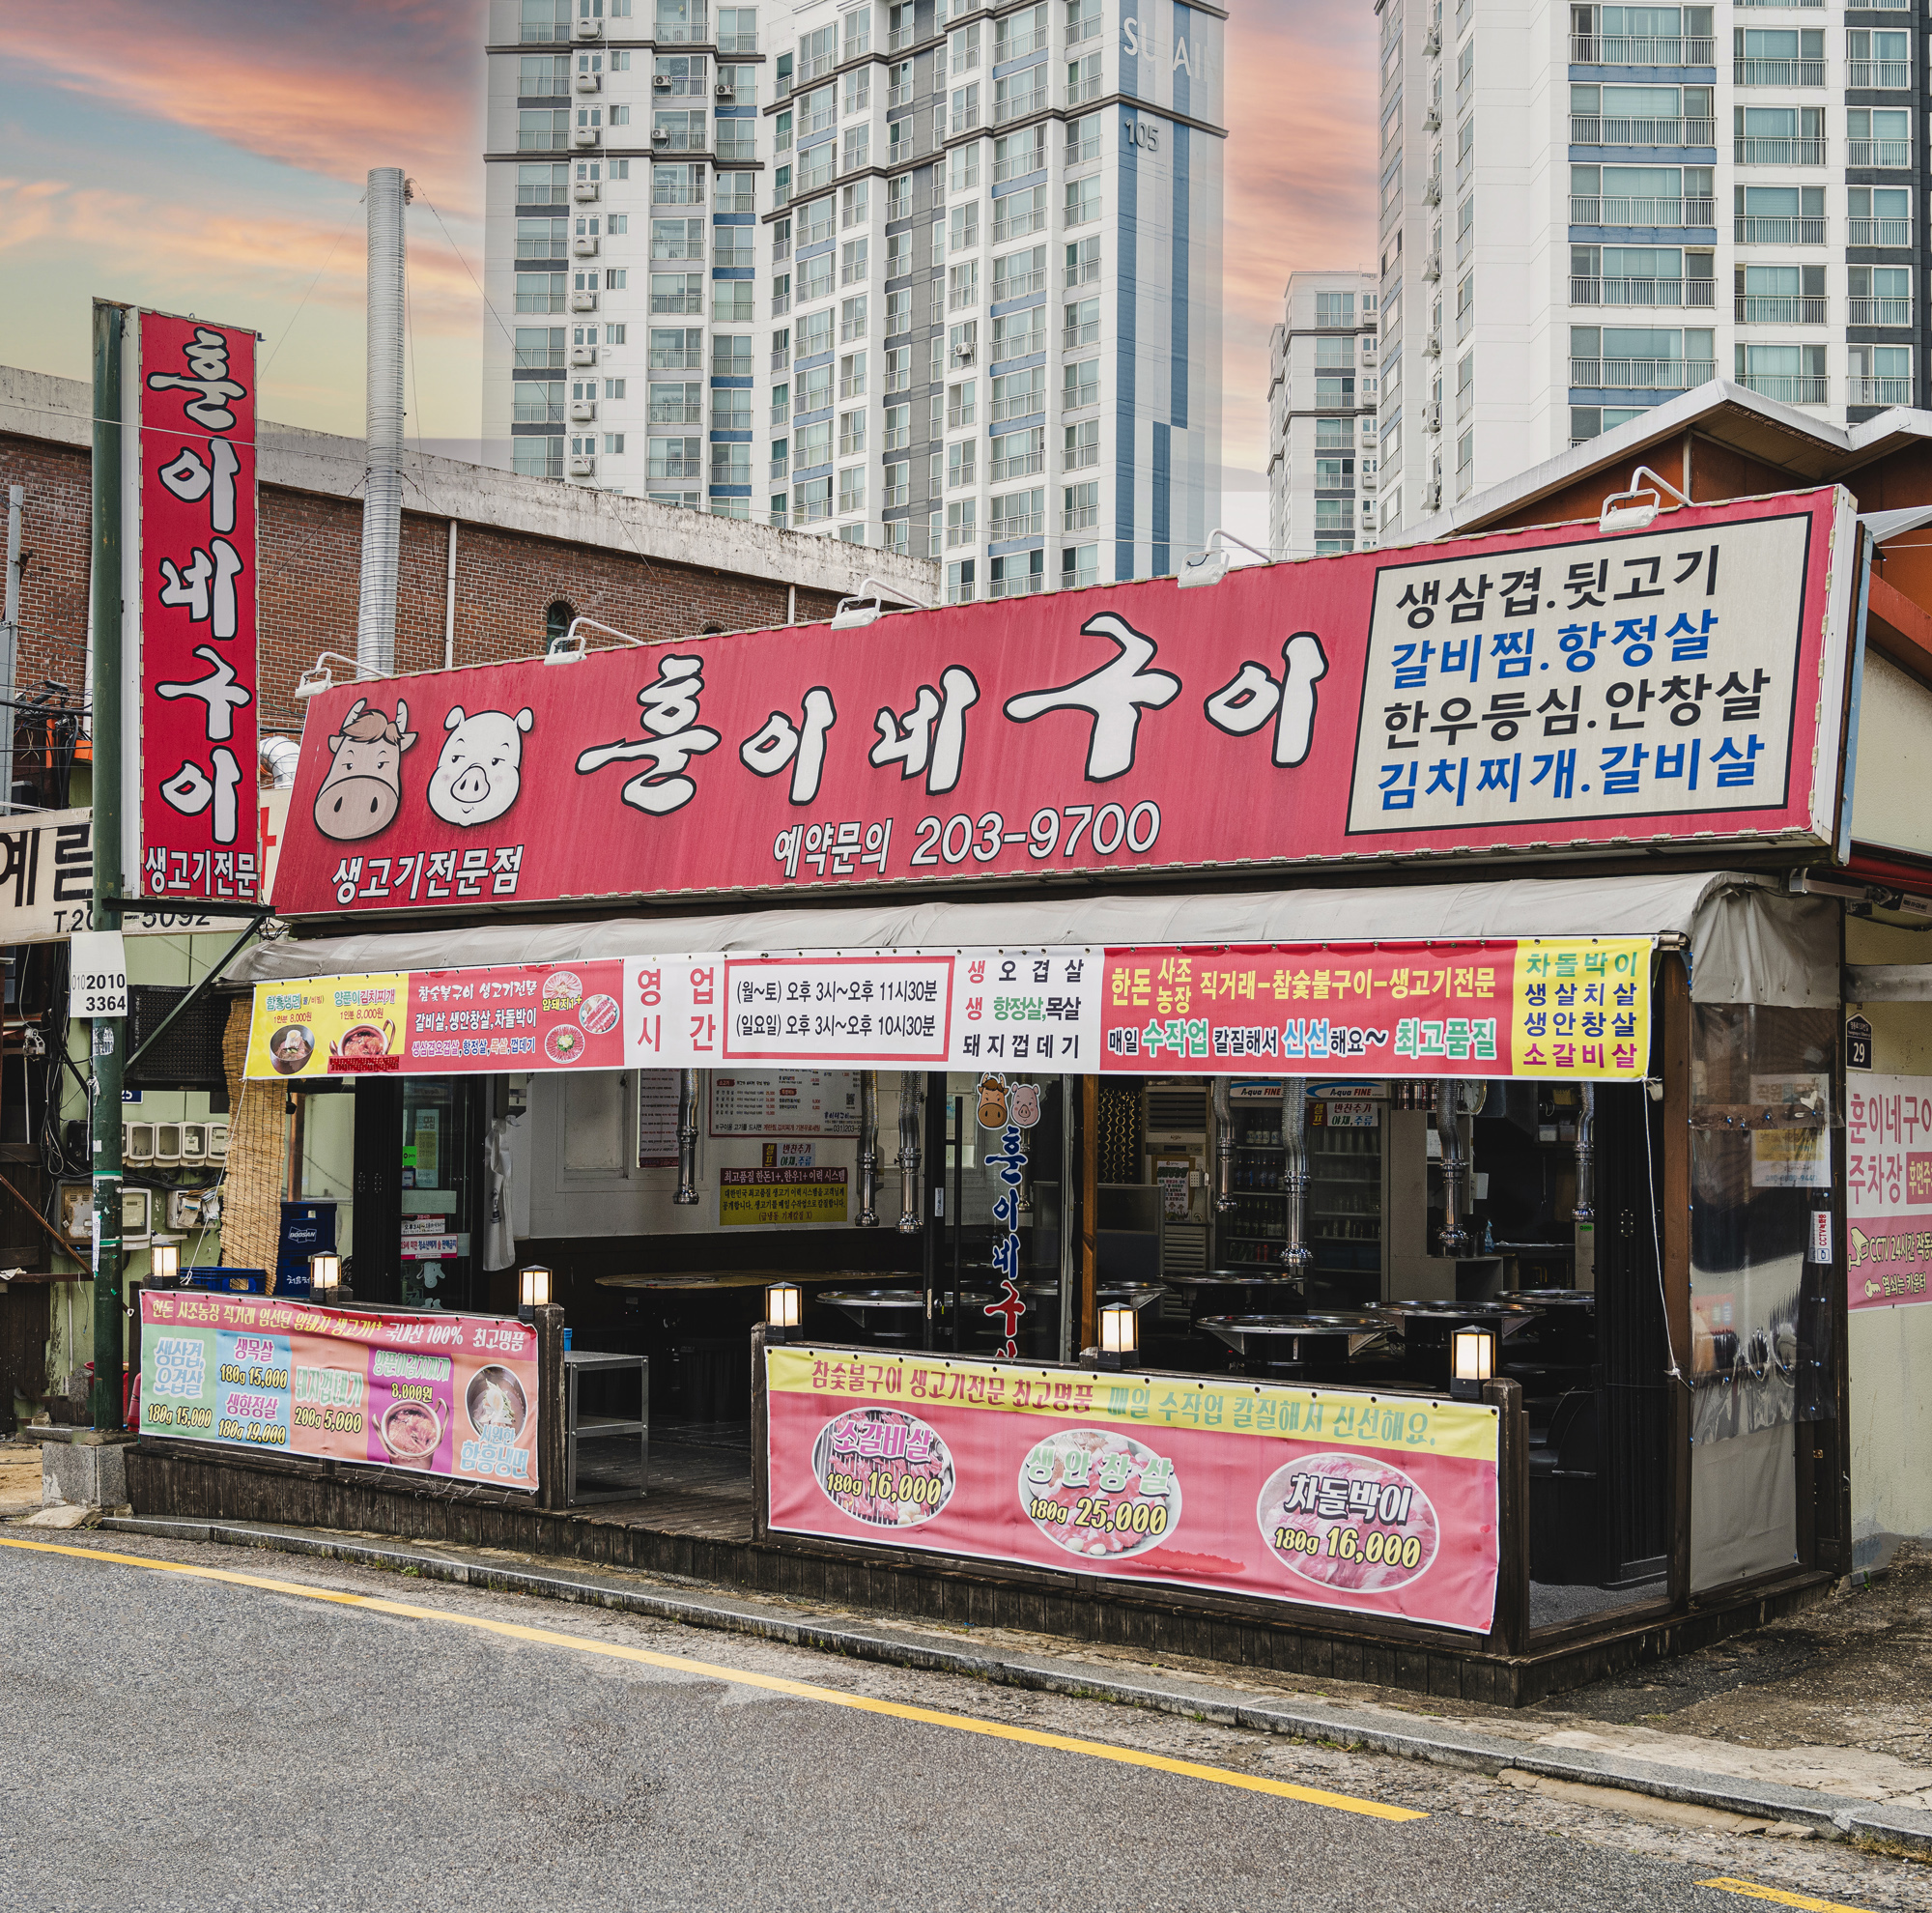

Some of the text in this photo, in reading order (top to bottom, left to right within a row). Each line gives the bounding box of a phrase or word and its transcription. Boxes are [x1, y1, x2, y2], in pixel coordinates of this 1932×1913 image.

[1124, 118, 1160, 152] 105
[146, 327, 253, 846] 훈이네구이
[574, 611, 1330, 817] 훈이네구이
[773, 800, 1161, 878] 예약문의 203-9700
[145, 846, 259, 899] 생고기전문
[331, 843, 525, 906] 생고기전문점
[1157, 956, 1192, 985] 사조
[1525, 951, 1638, 978] 차돌박이
[86, 973, 126, 990] 2010
[479, 980, 538, 999] 생고기전문
[736, 980, 938, 1004] (월~토) 오후 3시~오후 11시30분
[1111, 967, 1151, 1007] 한돈
[1524, 981, 1637, 1008] 생살치살
[86, 995, 126, 1012] 3364
[334, 988, 396, 1007] 양푼이김치찌개
[1156, 985, 1192, 1014] 농장
[273, 1012, 312, 1023] 1인분 8,000원
[340, 1008, 384, 1020] 1인분 8,000원
[735, 1014, 935, 1037] (일요일) 오후 3시~오후 10시30분
[1523, 1011, 1637, 1038] 생안창살
[1109, 1028, 1138, 1055] 매일
[1142, 1019, 1208, 1058] 수작업
[1213, 1026, 1279, 1057] 칼질해서
[1394, 1016, 1497, 1061] 최고품질
[1522, 1041, 1638, 1069] 소갈비살
[1853, 1042, 1865, 1063] 29
[1240, 1088, 1263, 1097] Aqua
[1330, 1088, 1351, 1097] Aqua
[1312, 1103, 1372, 1126] 셀프 반찬추가
[782, 1144, 811, 1155] 반찬추가
[724, 1169, 845, 1184] 최고품질 이력 시스템
[1848, 1154, 1932, 1205] 주차장 후면주
[724, 1188, 747, 1199] 대한민국
[748, 1187, 771, 1198] 최고품질
[772, 1187, 790, 1197] 생고기
[290, 1230, 316, 1240] DOOSAN
[1869, 1229, 1932, 1263] CCTV 24시간 작동
[287, 1274, 312, 1285] 처음처
[1882, 1271, 1926, 1298] 열쇠는 카운터
[153, 1299, 173, 1318] 한돈
[177, 1301, 220, 1322] 사조농장
[223, 1303, 256, 1325] 직거래
[259, 1308, 293, 1328] 엄선된
[294, 1312, 331, 1332] 암돼지
[385, 1323, 424, 1344] 국내산
[426, 1325, 464, 1345] 100%
[472, 1328, 526, 1352] 최고명품
[234, 1337, 274, 1362] 생목살
[220, 1364, 288, 1389] 180g 15,000
[373, 1350, 451, 1382] 양푼이김치찌개
[155, 1367, 204, 1397] 오겹살
[296, 1365, 364, 1408] 돼지껍데기
[391, 1383, 433, 1403] 8,000원
[226, 1392, 278, 1420] 생항정살
[811, 1359, 902, 1394] 참숯불구이
[909, 1369, 1006, 1404] 생고기전문
[1012, 1379, 1094, 1414] 최고명품
[1107, 1386, 1151, 1419] 매일
[1158, 1391, 1224, 1426] 수작업
[1234, 1396, 1323, 1433] 칼질해서
[148, 1404, 213, 1428] 180g 15,000
[295, 1407, 362, 1434] 200g 5,000
[218, 1418, 286, 1444] 180g 19,000
[479, 1424, 516, 1446] 시원한
[833, 1419, 934, 1465] 소갈비살
[460, 1440, 529, 1478] 함흥냉면
[827, 1470, 942, 1506] 180g 16,000
[1284, 1472, 1413, 1527] 차돌박이
[1030, 1498, 1169, 1536] 180g 25,000
[1275, 1527, 1422, 1569] 180g 16,000
